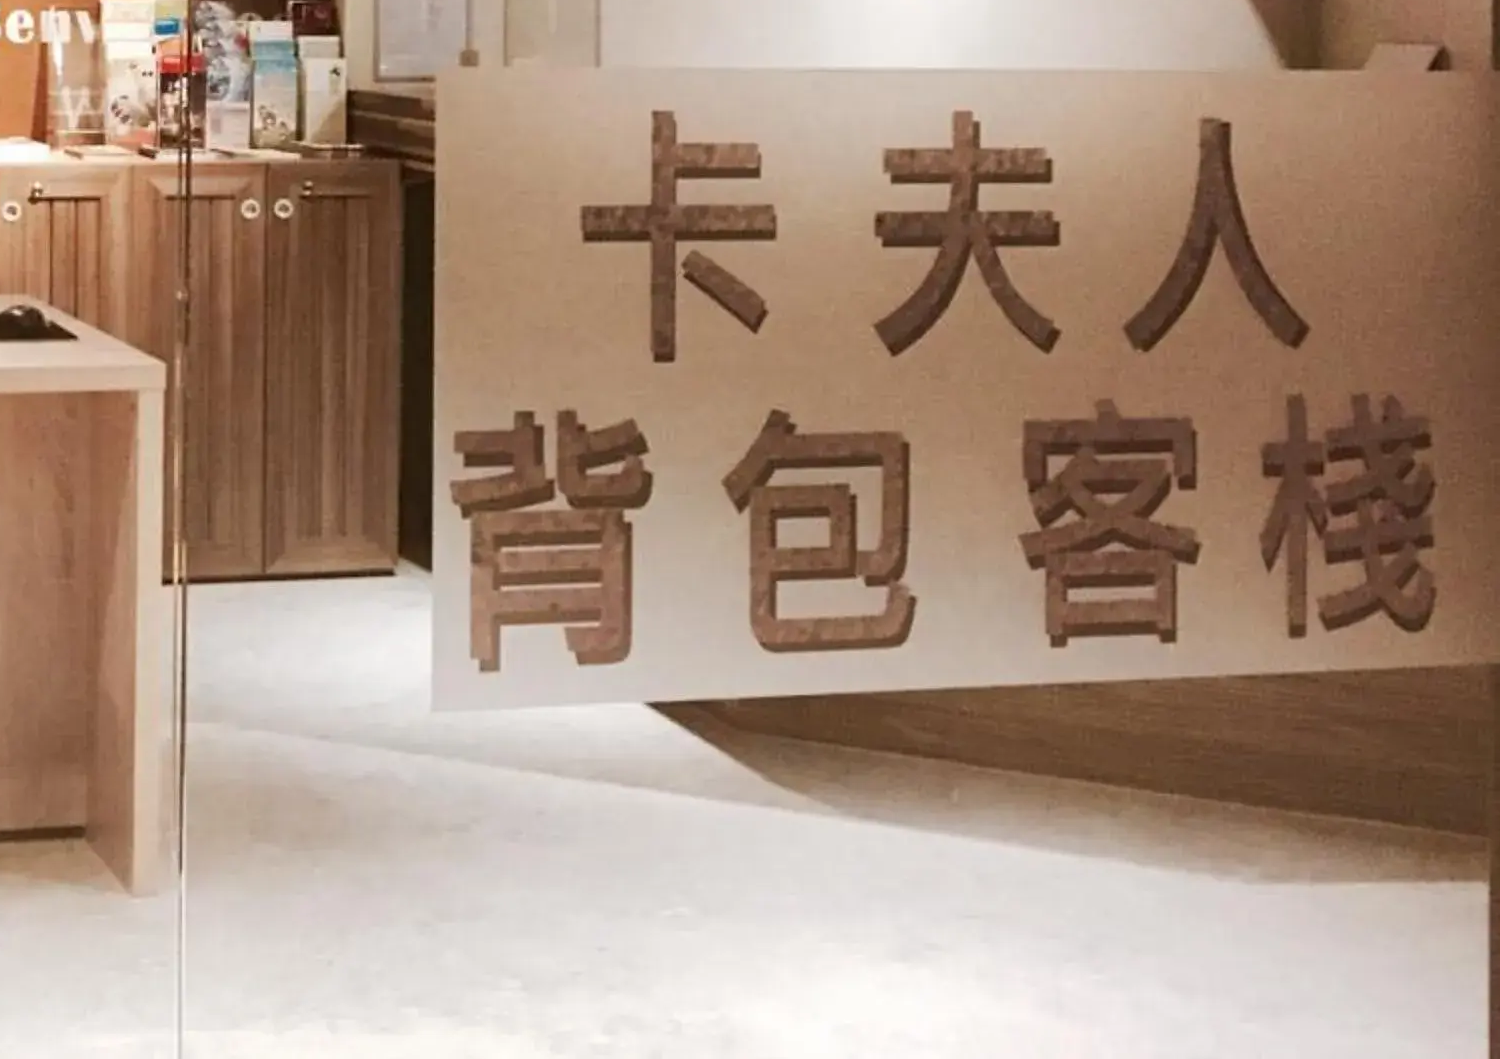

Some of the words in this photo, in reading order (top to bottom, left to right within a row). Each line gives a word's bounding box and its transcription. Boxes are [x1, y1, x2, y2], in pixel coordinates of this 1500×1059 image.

[581, 109, 1310, 363] 卡夫人
[450, 392, 1438, 673] 背包客棧
